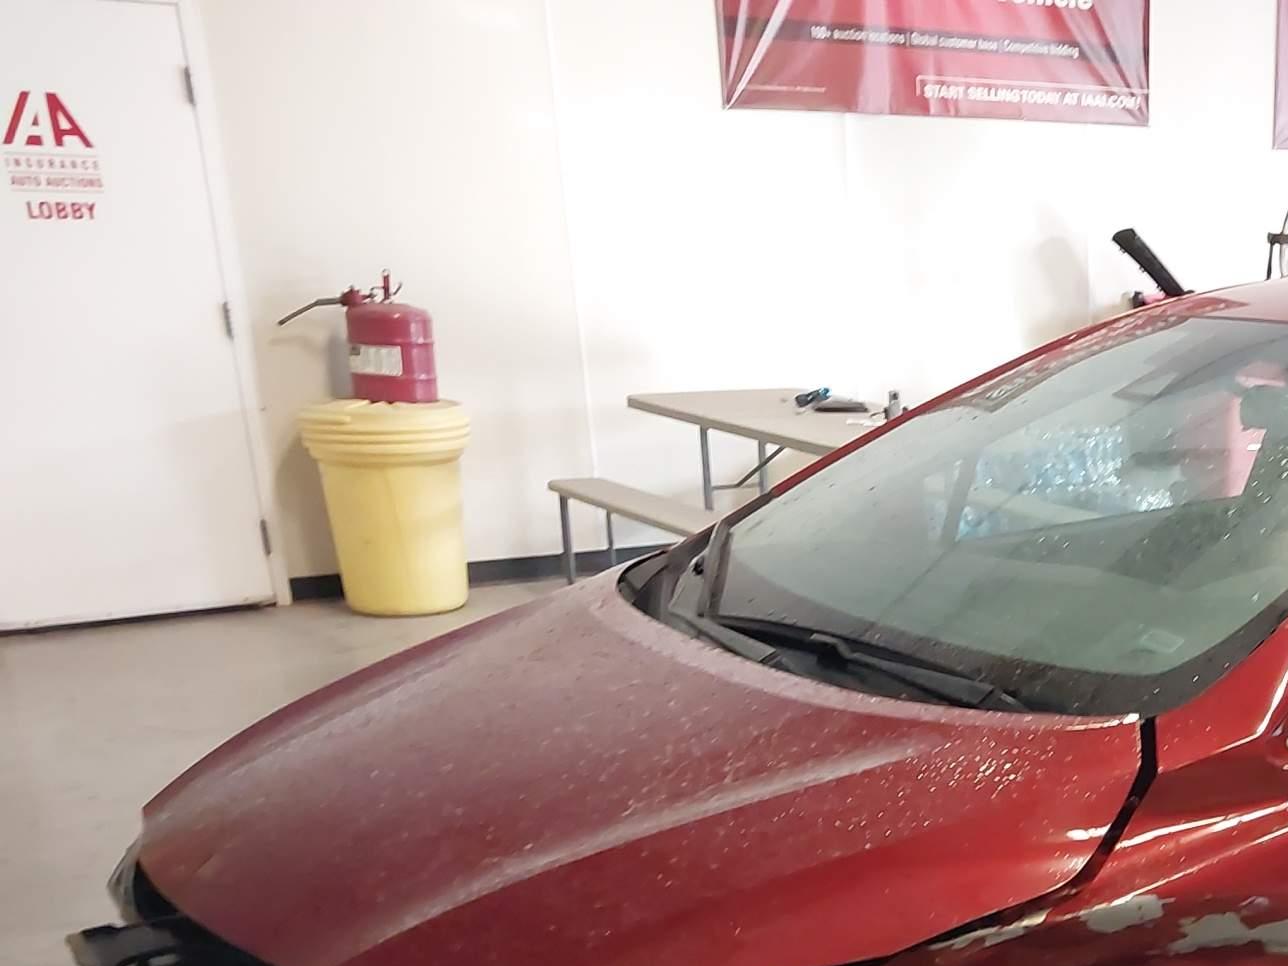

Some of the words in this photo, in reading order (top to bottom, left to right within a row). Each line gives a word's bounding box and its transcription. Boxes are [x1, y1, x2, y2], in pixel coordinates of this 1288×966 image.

[923, 84, 964, 99] START
[967, 86, 1021, 102] SELLING
[1021, 89, 1062, 105] TODAY
[1063, 92, 1078, 105] AT
[4, 157, 100, 171] INSURANCE
[11, 175, 42, 187] AUTO
[46, 176, 103, 189] AUCTIONS
[26, 200, 96, 220] LOBBY
